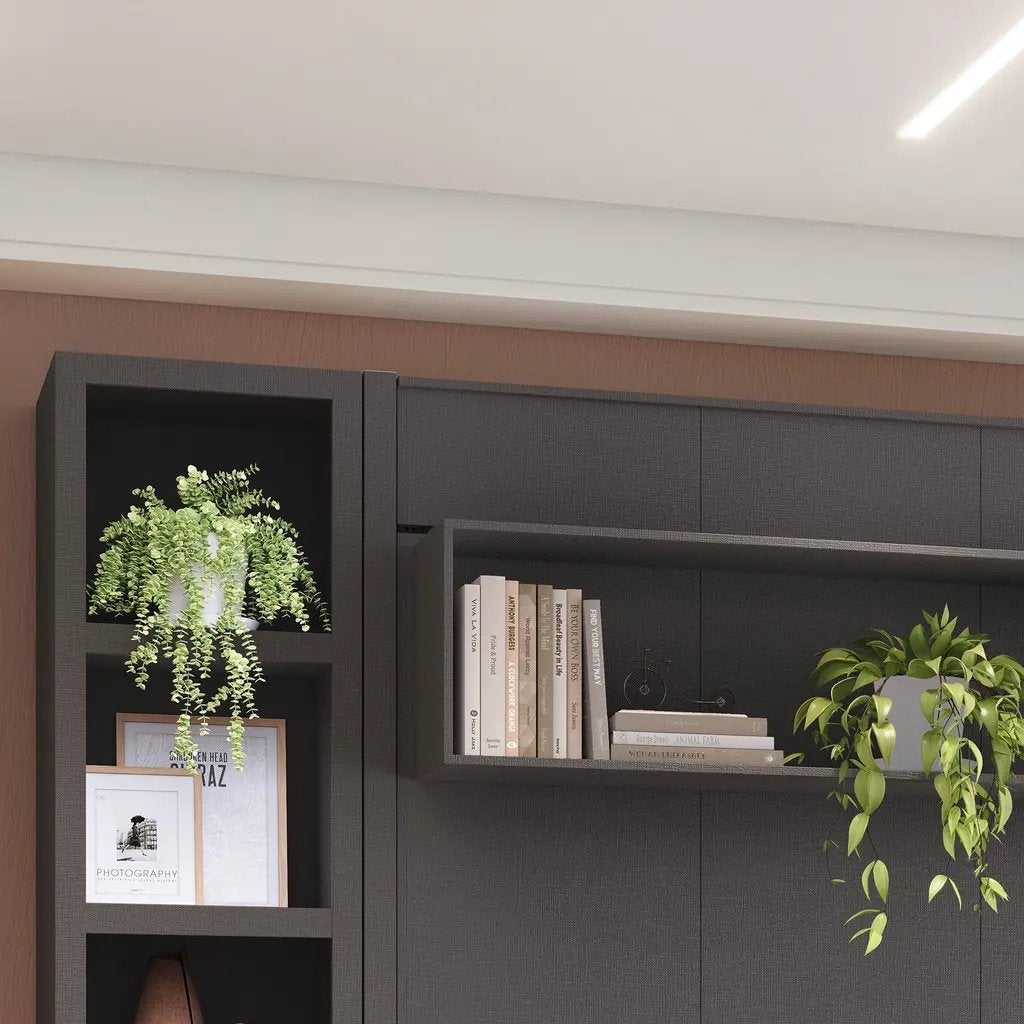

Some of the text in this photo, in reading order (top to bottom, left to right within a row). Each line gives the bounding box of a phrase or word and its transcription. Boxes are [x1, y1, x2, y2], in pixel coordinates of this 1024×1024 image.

[472, 620, 478, 630] LA
[508, 595, 516, 651] ANTHONY BURGESS
[555, 604, 563, 634] Broadleaf
[555, 635, 563, 656] Beauty
[571, 605, 580, 681] BE YOUR OWN BOSS
[590, 609, 602, 686] FIND YOUR BEST WAY
[555, 665, 563, 676] Life
[508, 668, 516, 707] CLOCKWORK
[508, 709, 516, 732] ORANGE
[209, 752, 228, 763] HEAD
[96, 868, 178, 879] PHOTOGRAPHY
